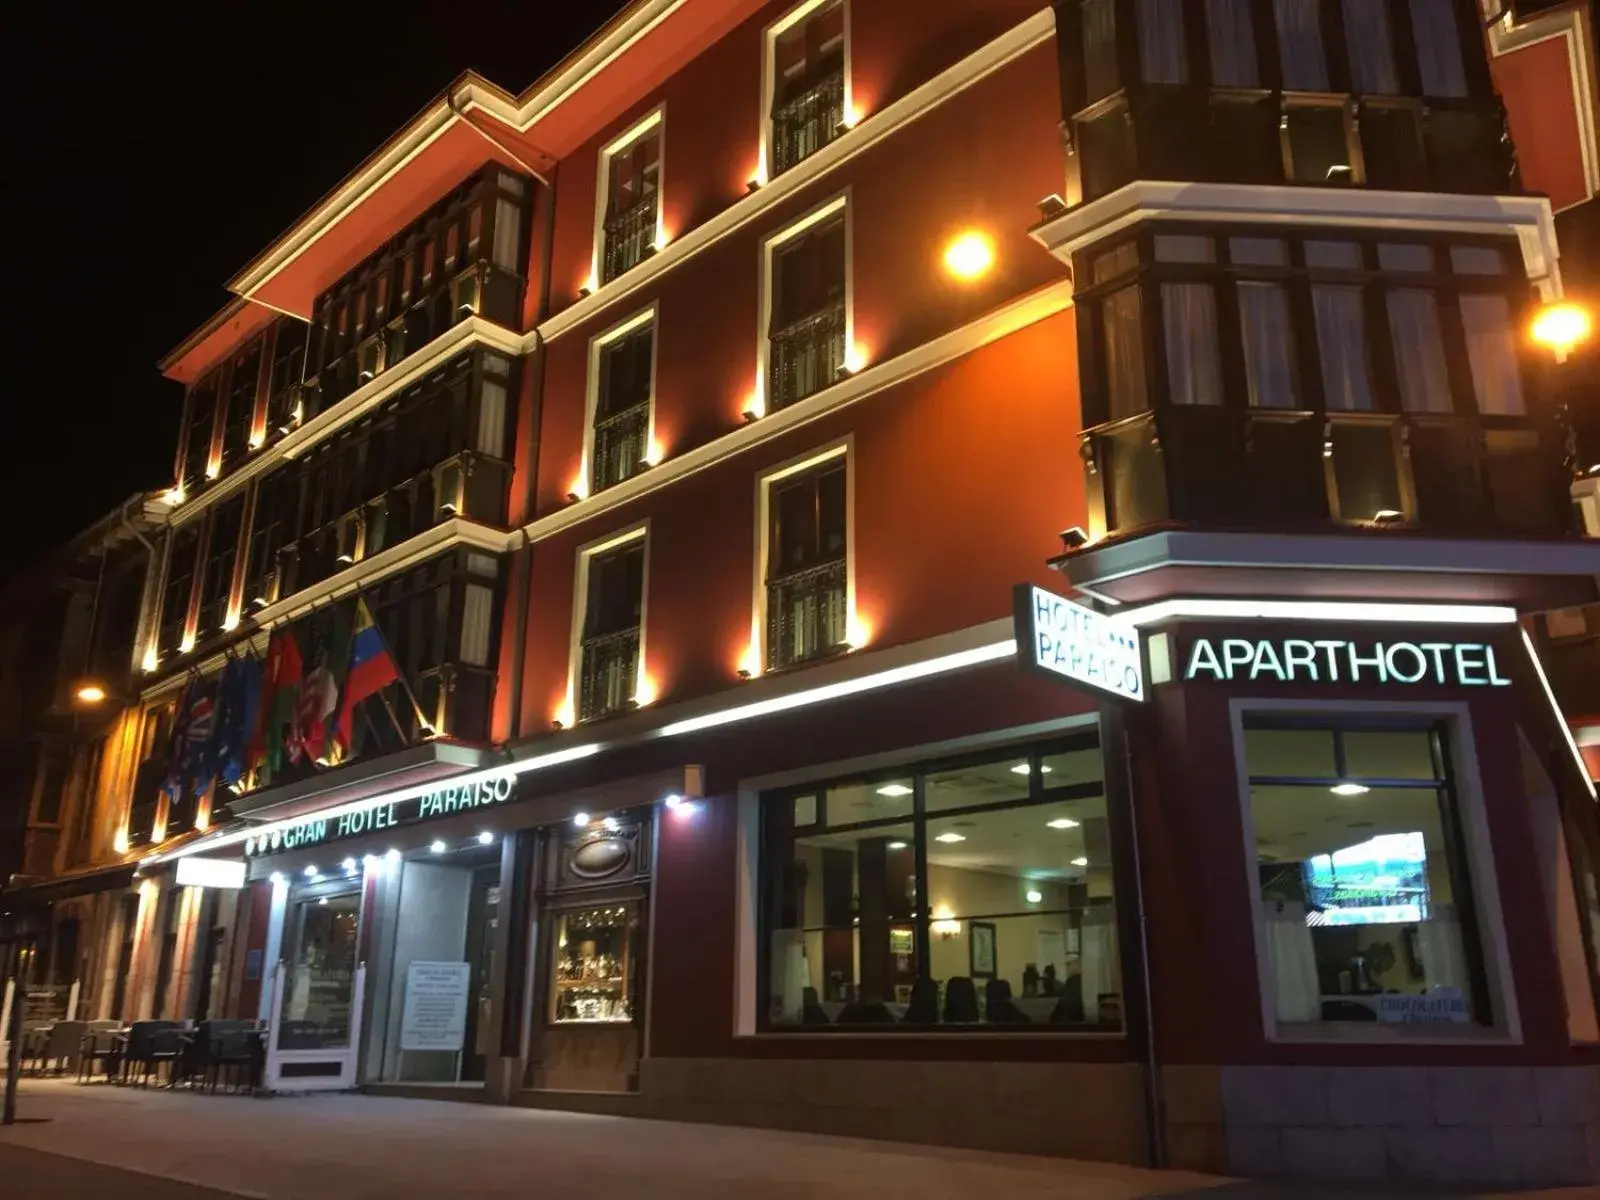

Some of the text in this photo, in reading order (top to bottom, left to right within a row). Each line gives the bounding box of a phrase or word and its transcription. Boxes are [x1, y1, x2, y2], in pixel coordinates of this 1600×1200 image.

[1036, 593, 1106, 648] HOTEL
[1185, 638, 1512, 687] APARTHOTEL
[283, 777, 513, 849] GRAN HOTEL PARAISO
